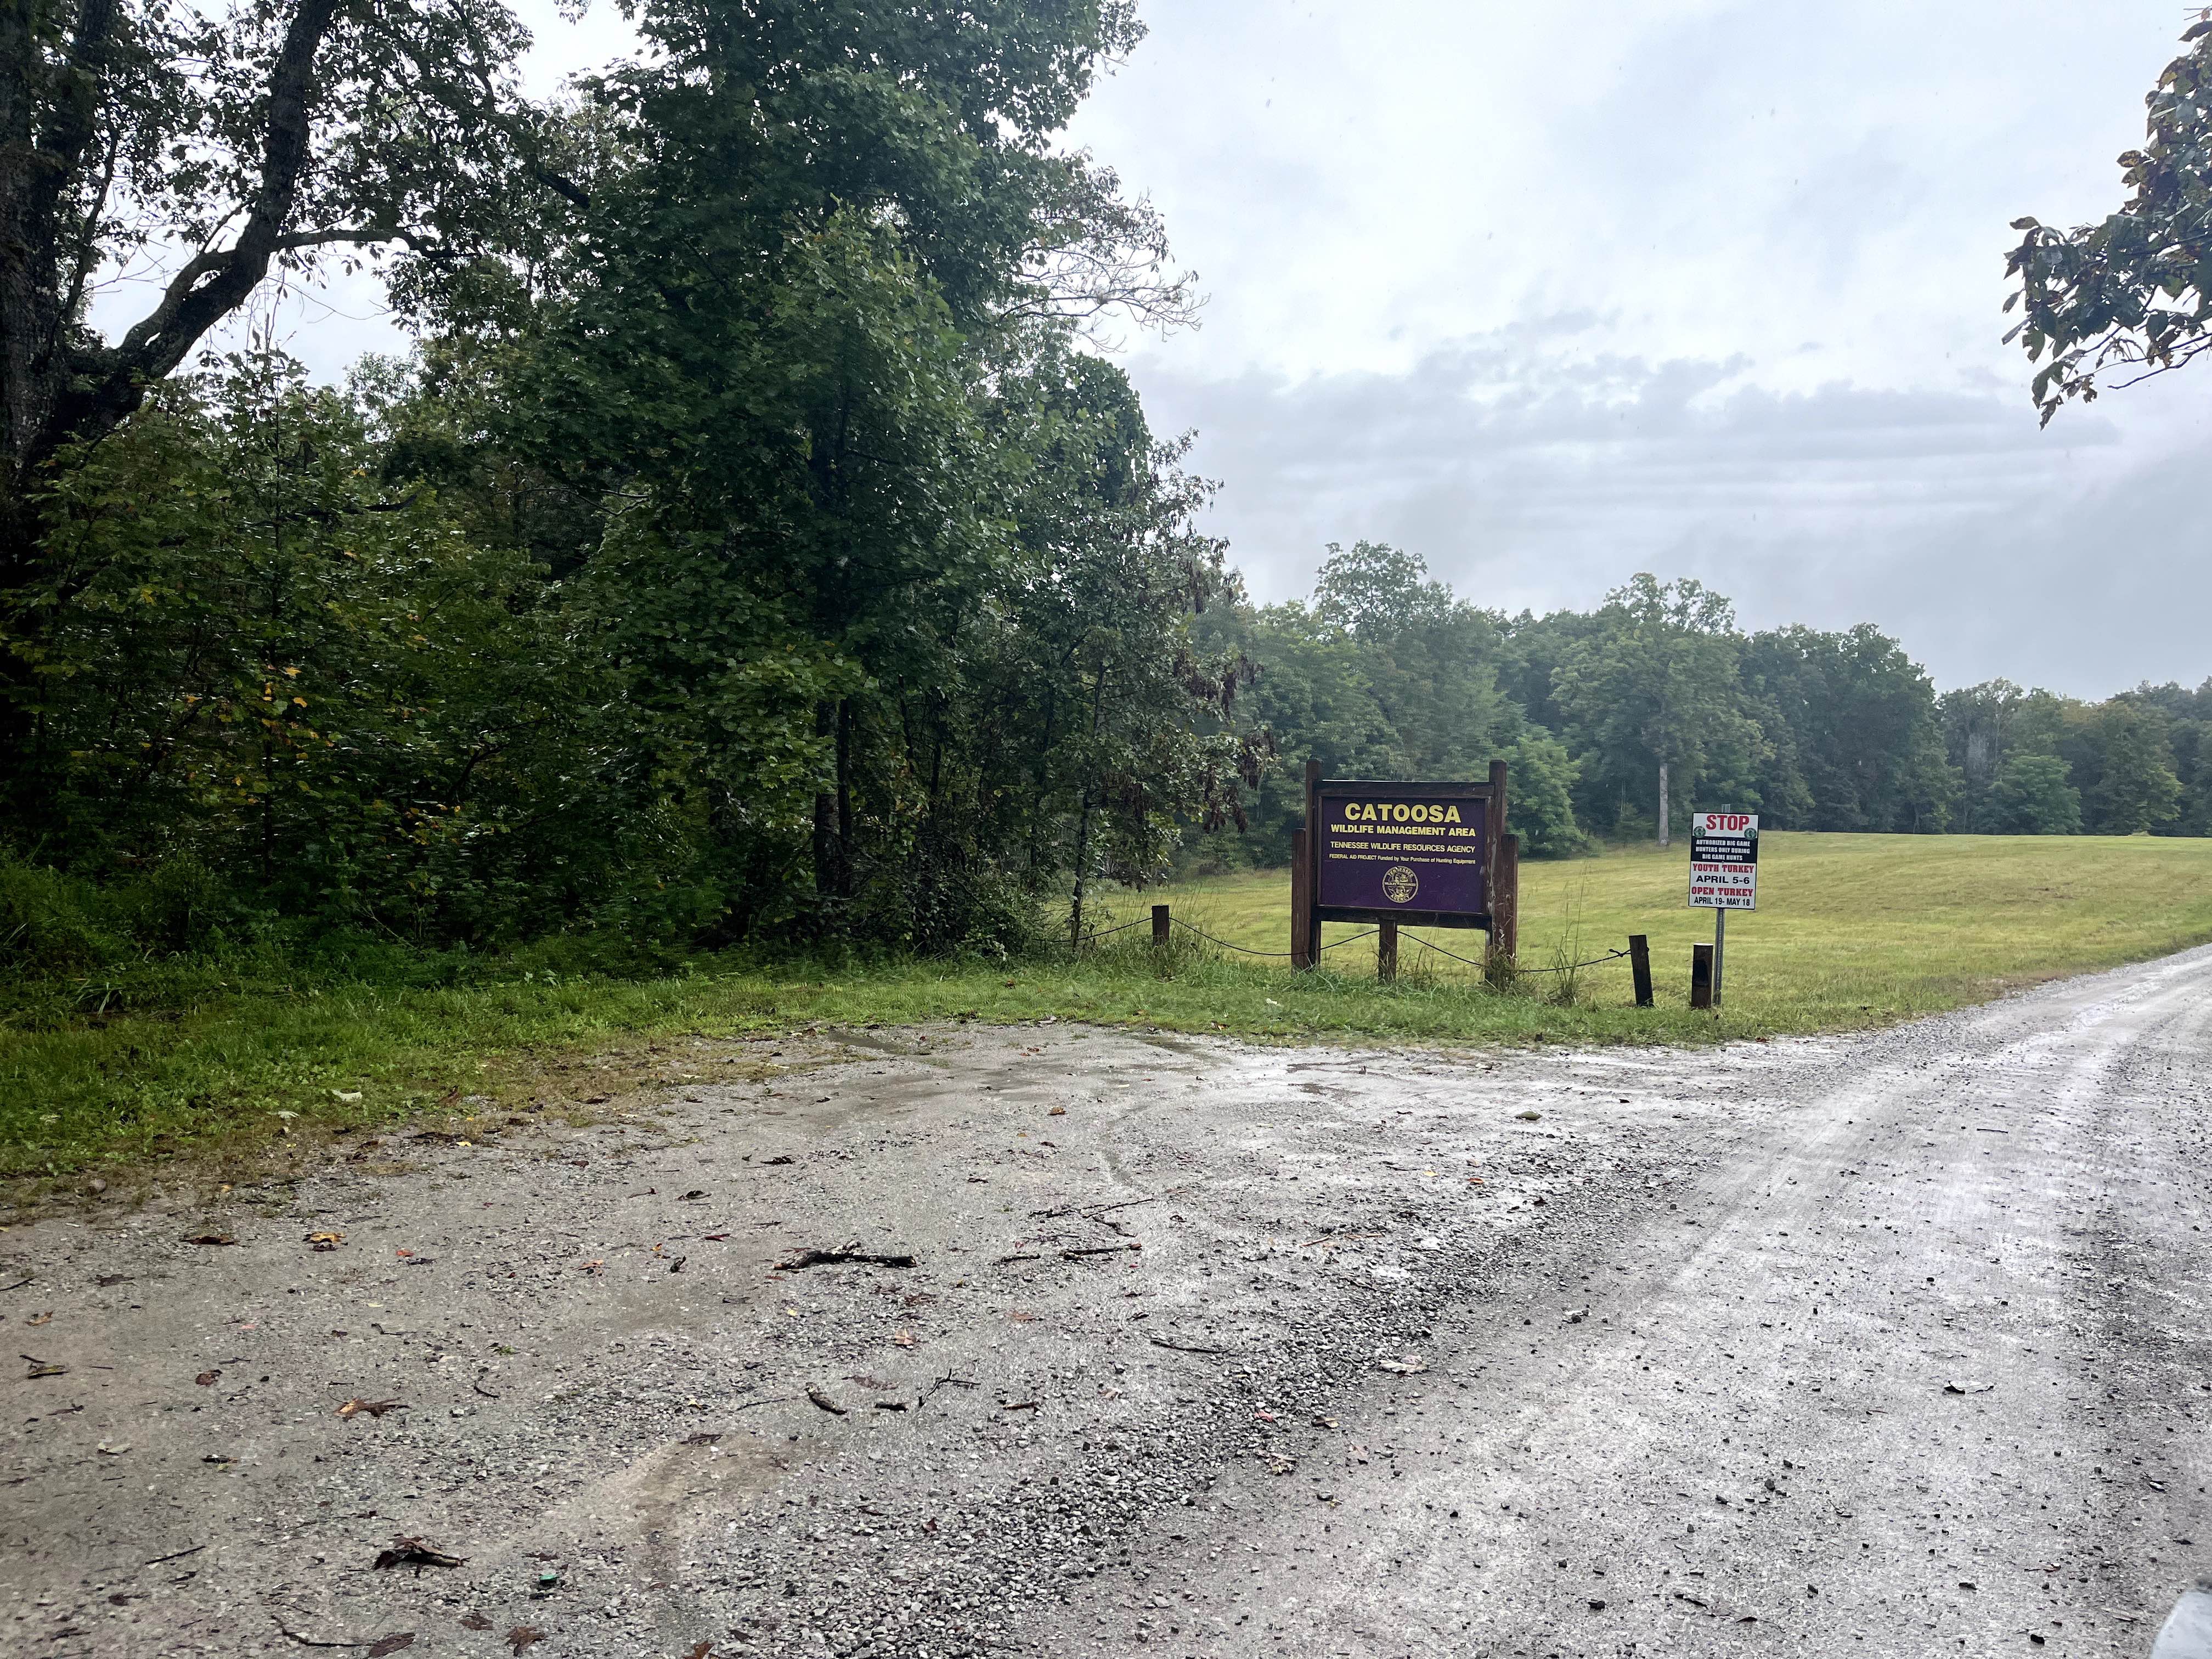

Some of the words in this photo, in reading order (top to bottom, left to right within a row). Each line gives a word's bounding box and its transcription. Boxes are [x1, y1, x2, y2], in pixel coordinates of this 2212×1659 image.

[1345, 803, 1461, 822] CATOOSA
[1706, 814, 1750, 831] STOP
[1331, 824, 1374, 833] WILDLIFE
[1376, 825, 1446, 836] MANAGEMENT
[1448, 827, 1476, 837] AREA
[1330, 841, 1369, 849] TENNESSEE
[1370, 842, 1401, 850] WILDLIFE
[1403, 844, 1445, 852] RESOURCES
[1447, 845, 1476, 853] AGENCY
[1693, 864, 1719, 872] YOUTH
[1722, 865, 1754, 873] TURKEY
[1696, 875, 1729, 883] APRIL
[1733, 876, 1750, 884] 5-6
[1691, 887, 1714, 895] OPEN
[1717, 887, 1753, 896] TURKEY
[1694, 896, 1713, 905] APRIL
[1726, 898, 1741, 906] MAY
